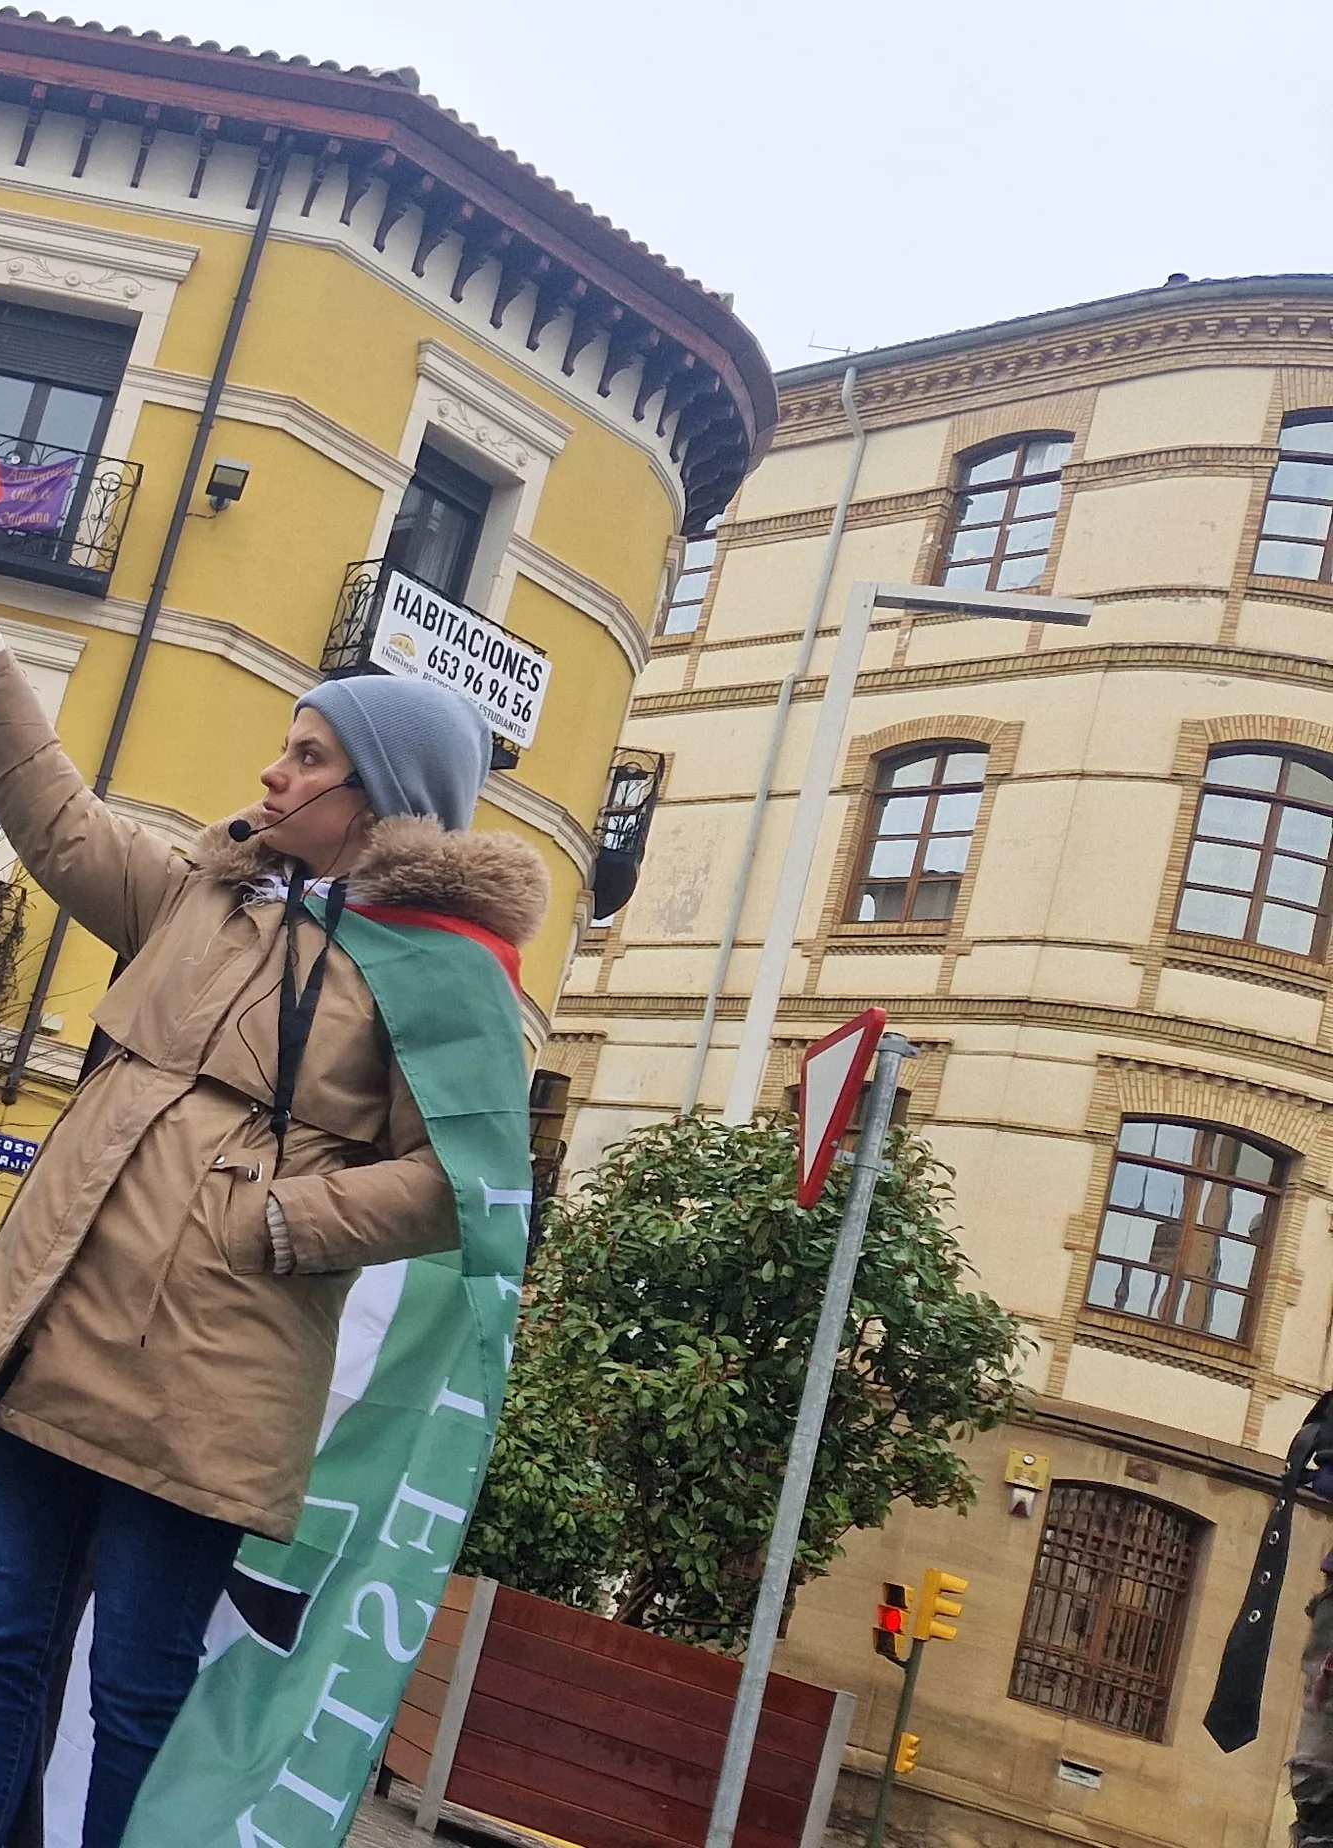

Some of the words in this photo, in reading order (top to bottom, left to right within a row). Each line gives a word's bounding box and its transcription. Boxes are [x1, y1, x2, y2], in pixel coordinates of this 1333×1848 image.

[381, 646, 419, 675] Domingo
[392, 583, 543, 692] HABITACIONES
[427, 645, 461, 681] 653
[463, 664, 485, 695] 96
[488, 678, 509, 709] 96
[511, 692, 533, 723] 56
